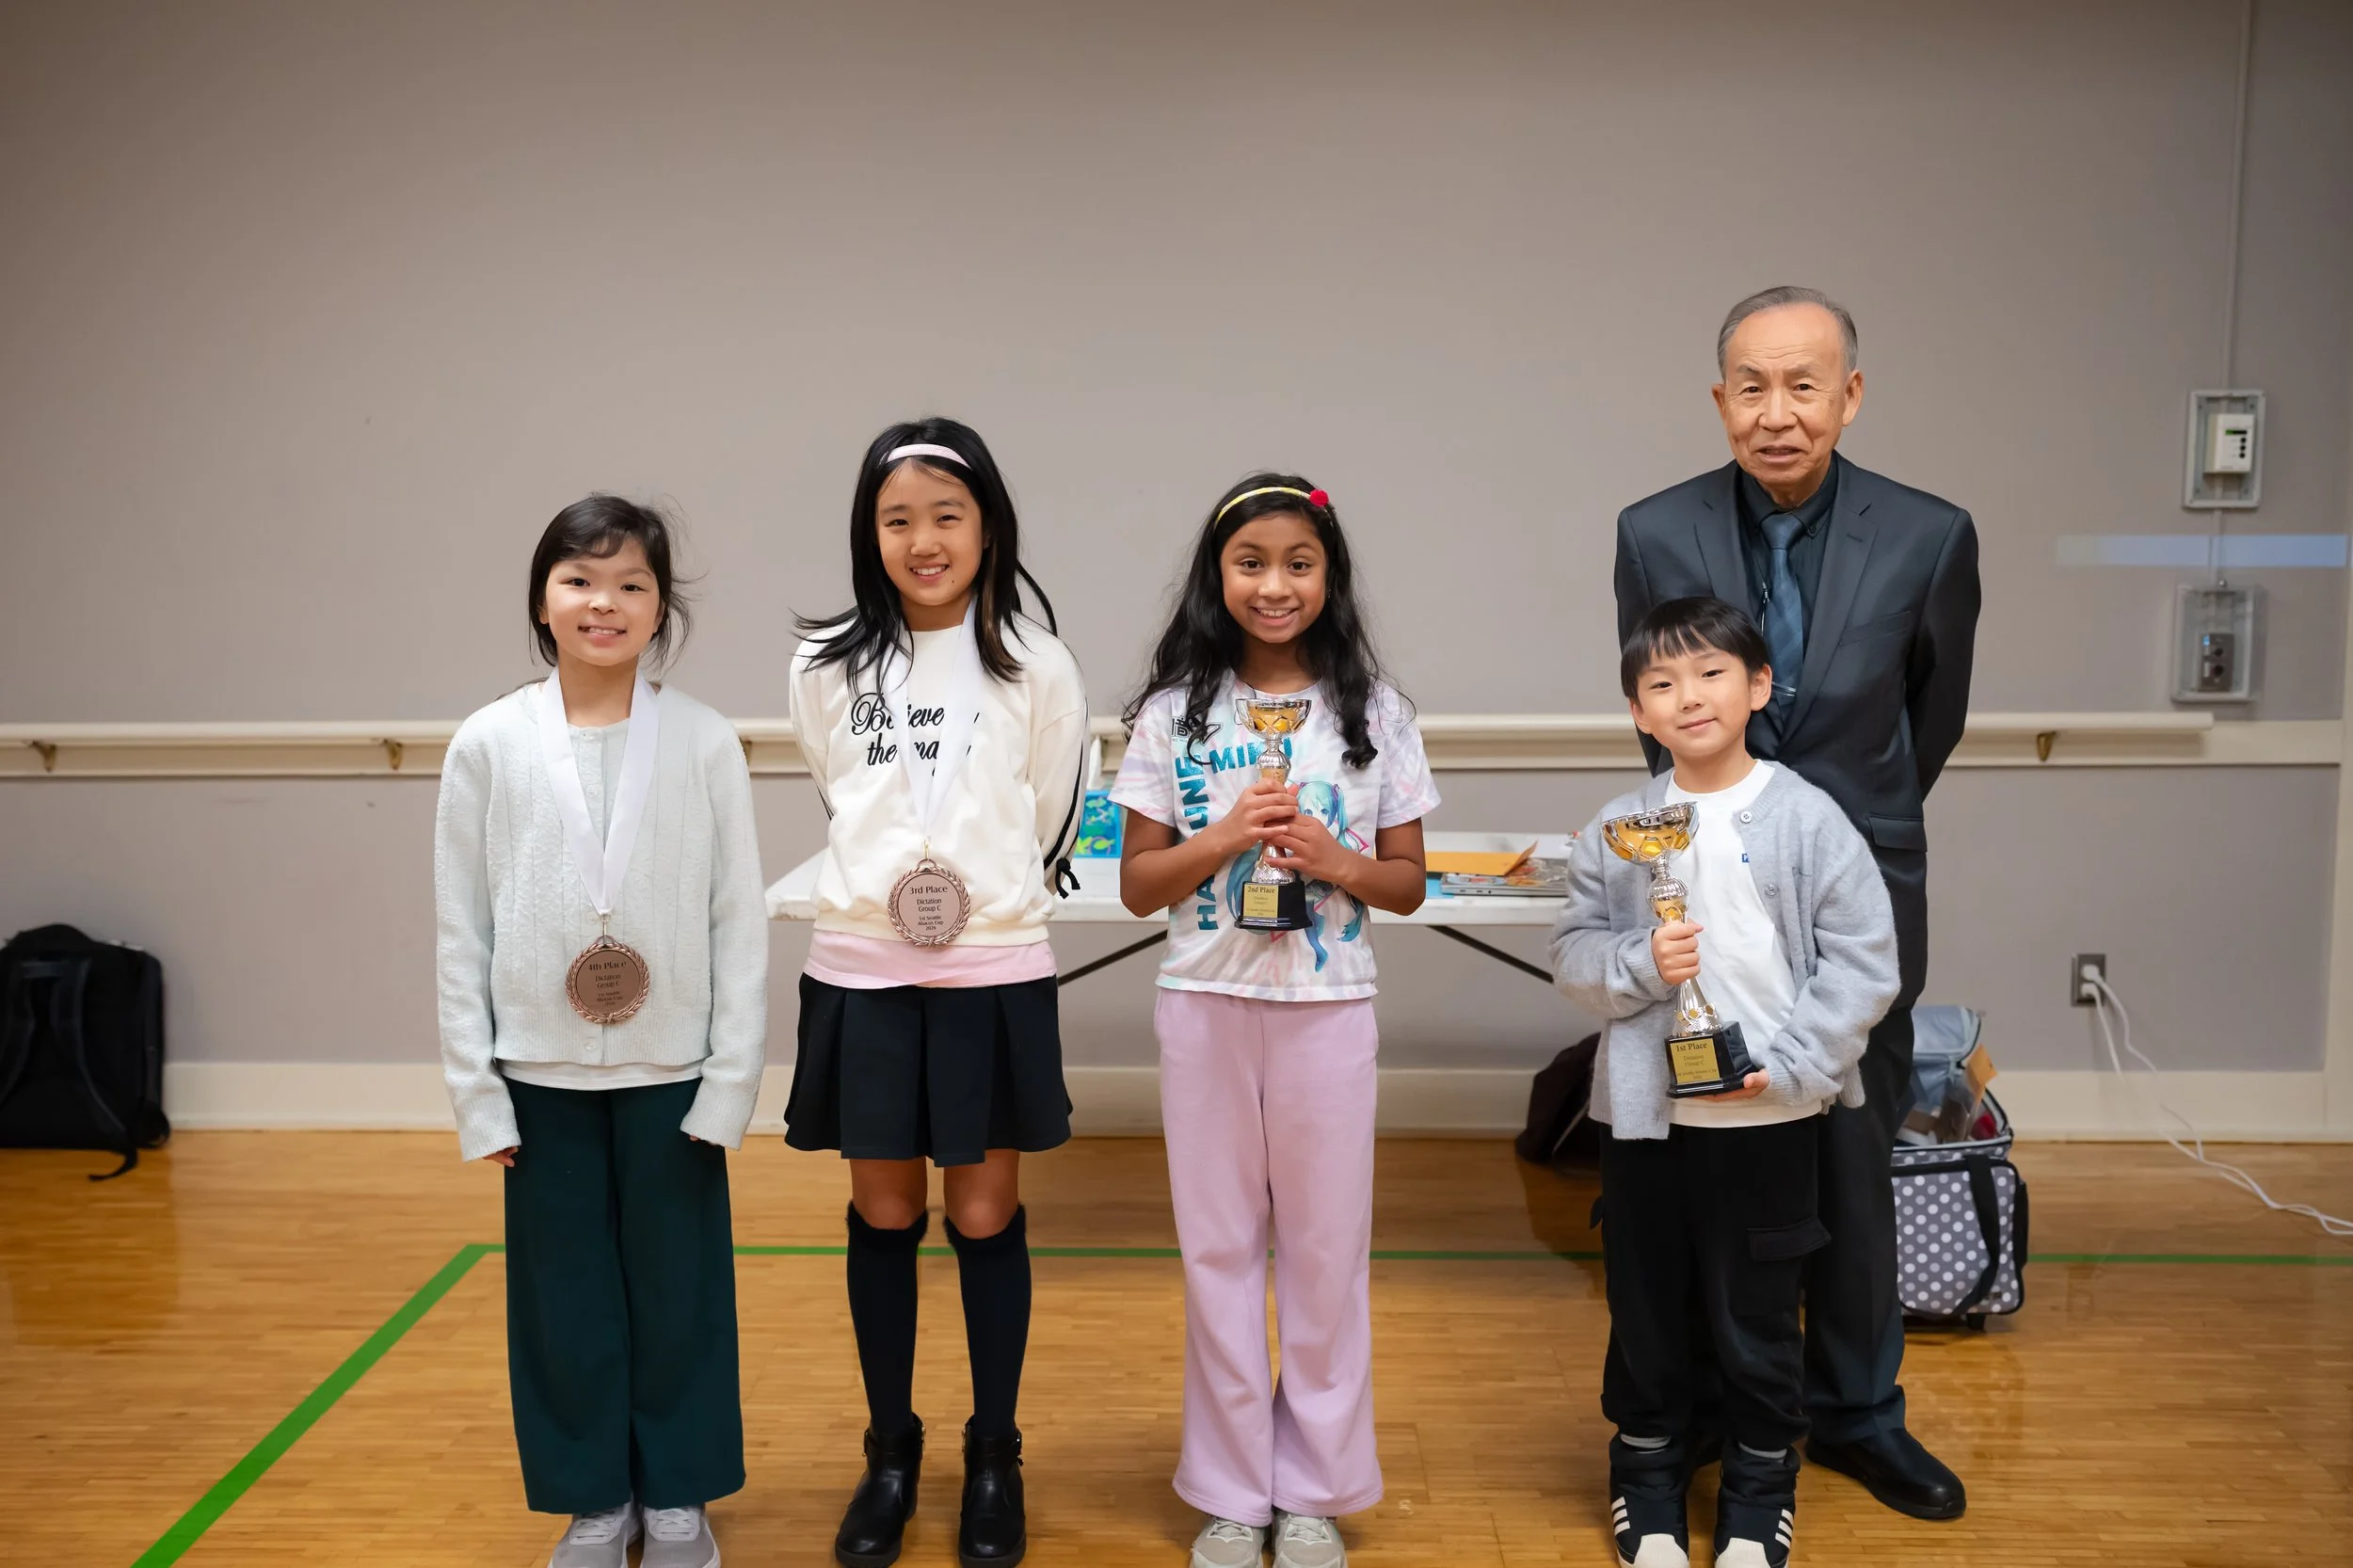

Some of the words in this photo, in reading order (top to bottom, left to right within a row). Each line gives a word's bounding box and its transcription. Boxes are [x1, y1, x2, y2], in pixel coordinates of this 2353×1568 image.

[851, 693, 944, 735] Beieve
[867, 732, 897, 766] the
[1175, 755, 1219, 930] HAUNE
[910, 886, 923, 894] 3rd
[604, 961, 627, 969] Place
[1688, 1042, 1707, 1050] Place
